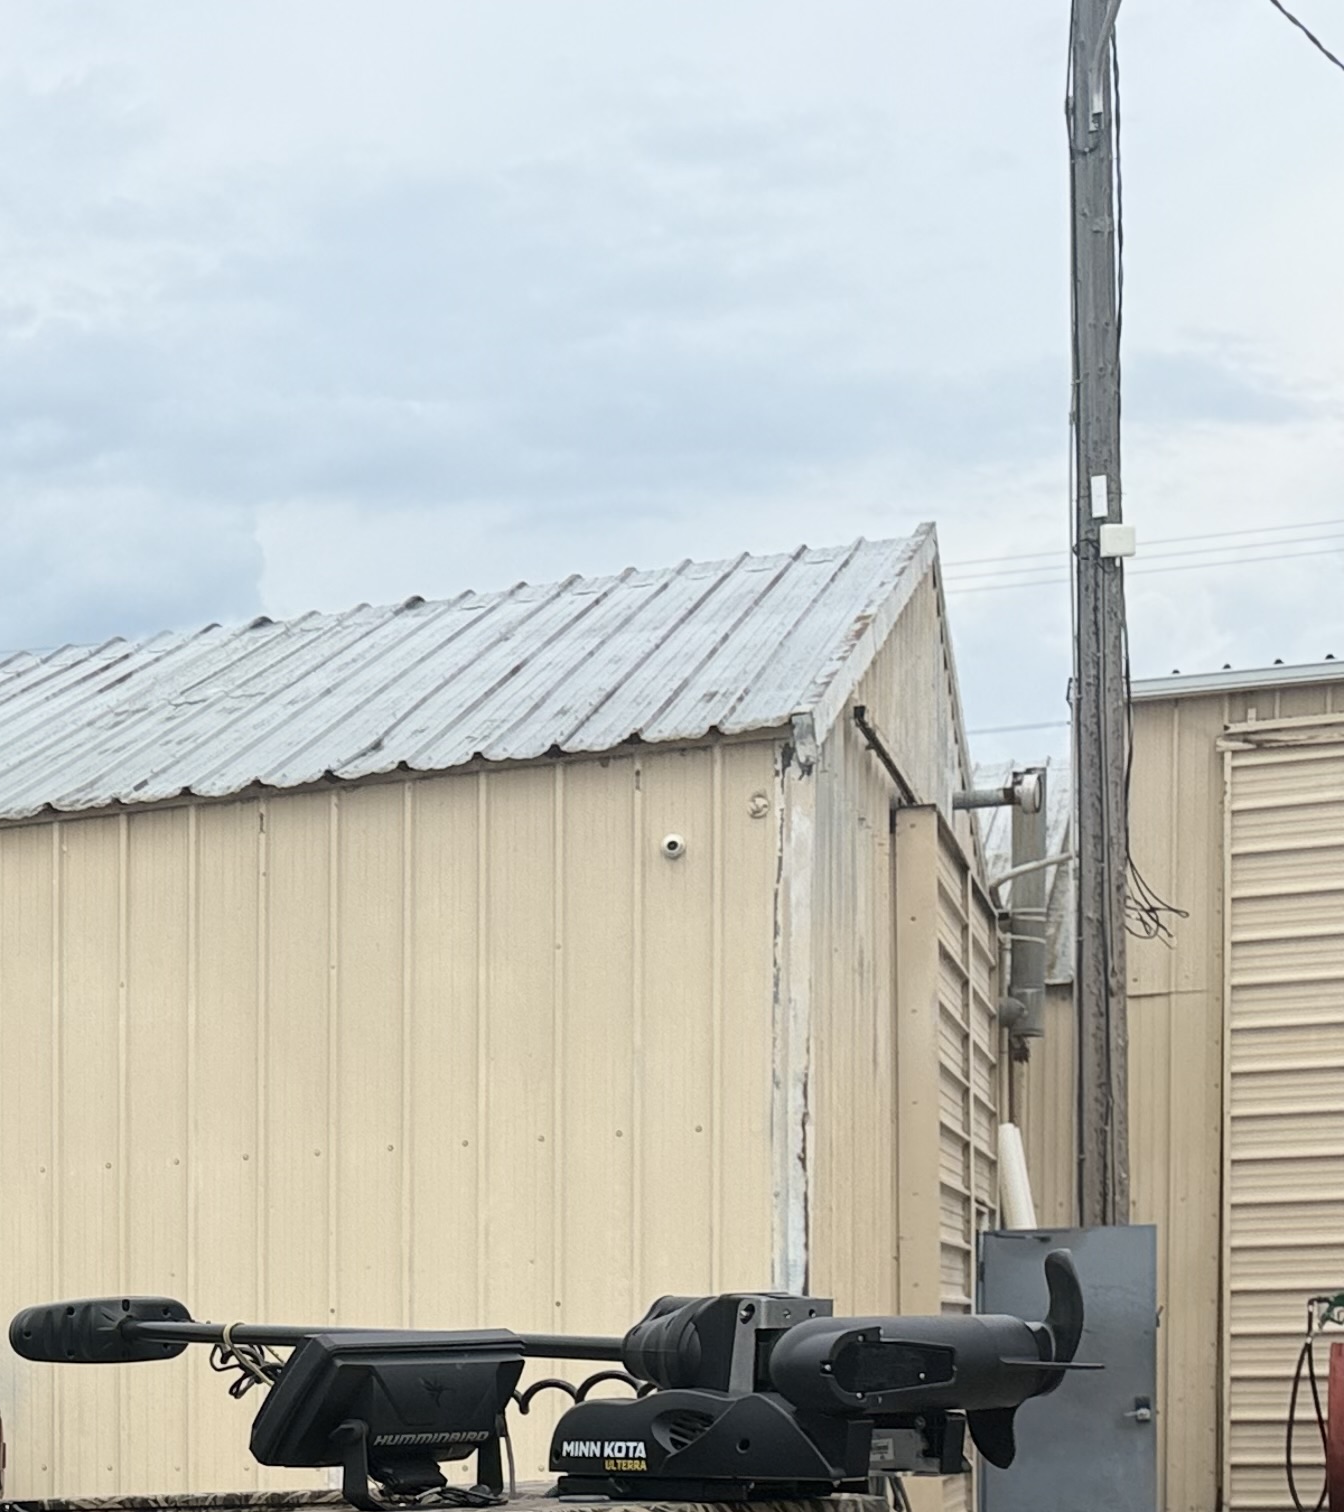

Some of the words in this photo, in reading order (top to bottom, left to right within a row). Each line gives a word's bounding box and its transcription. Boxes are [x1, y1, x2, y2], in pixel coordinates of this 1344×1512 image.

[373, 1430, 490, 1446] HUMMINBIRD
[562, 1440, 601, 1457] MINN
[604, 1441, 647, 1459] KOTA
[604, 1459, 647, 1471] ULTERRA
